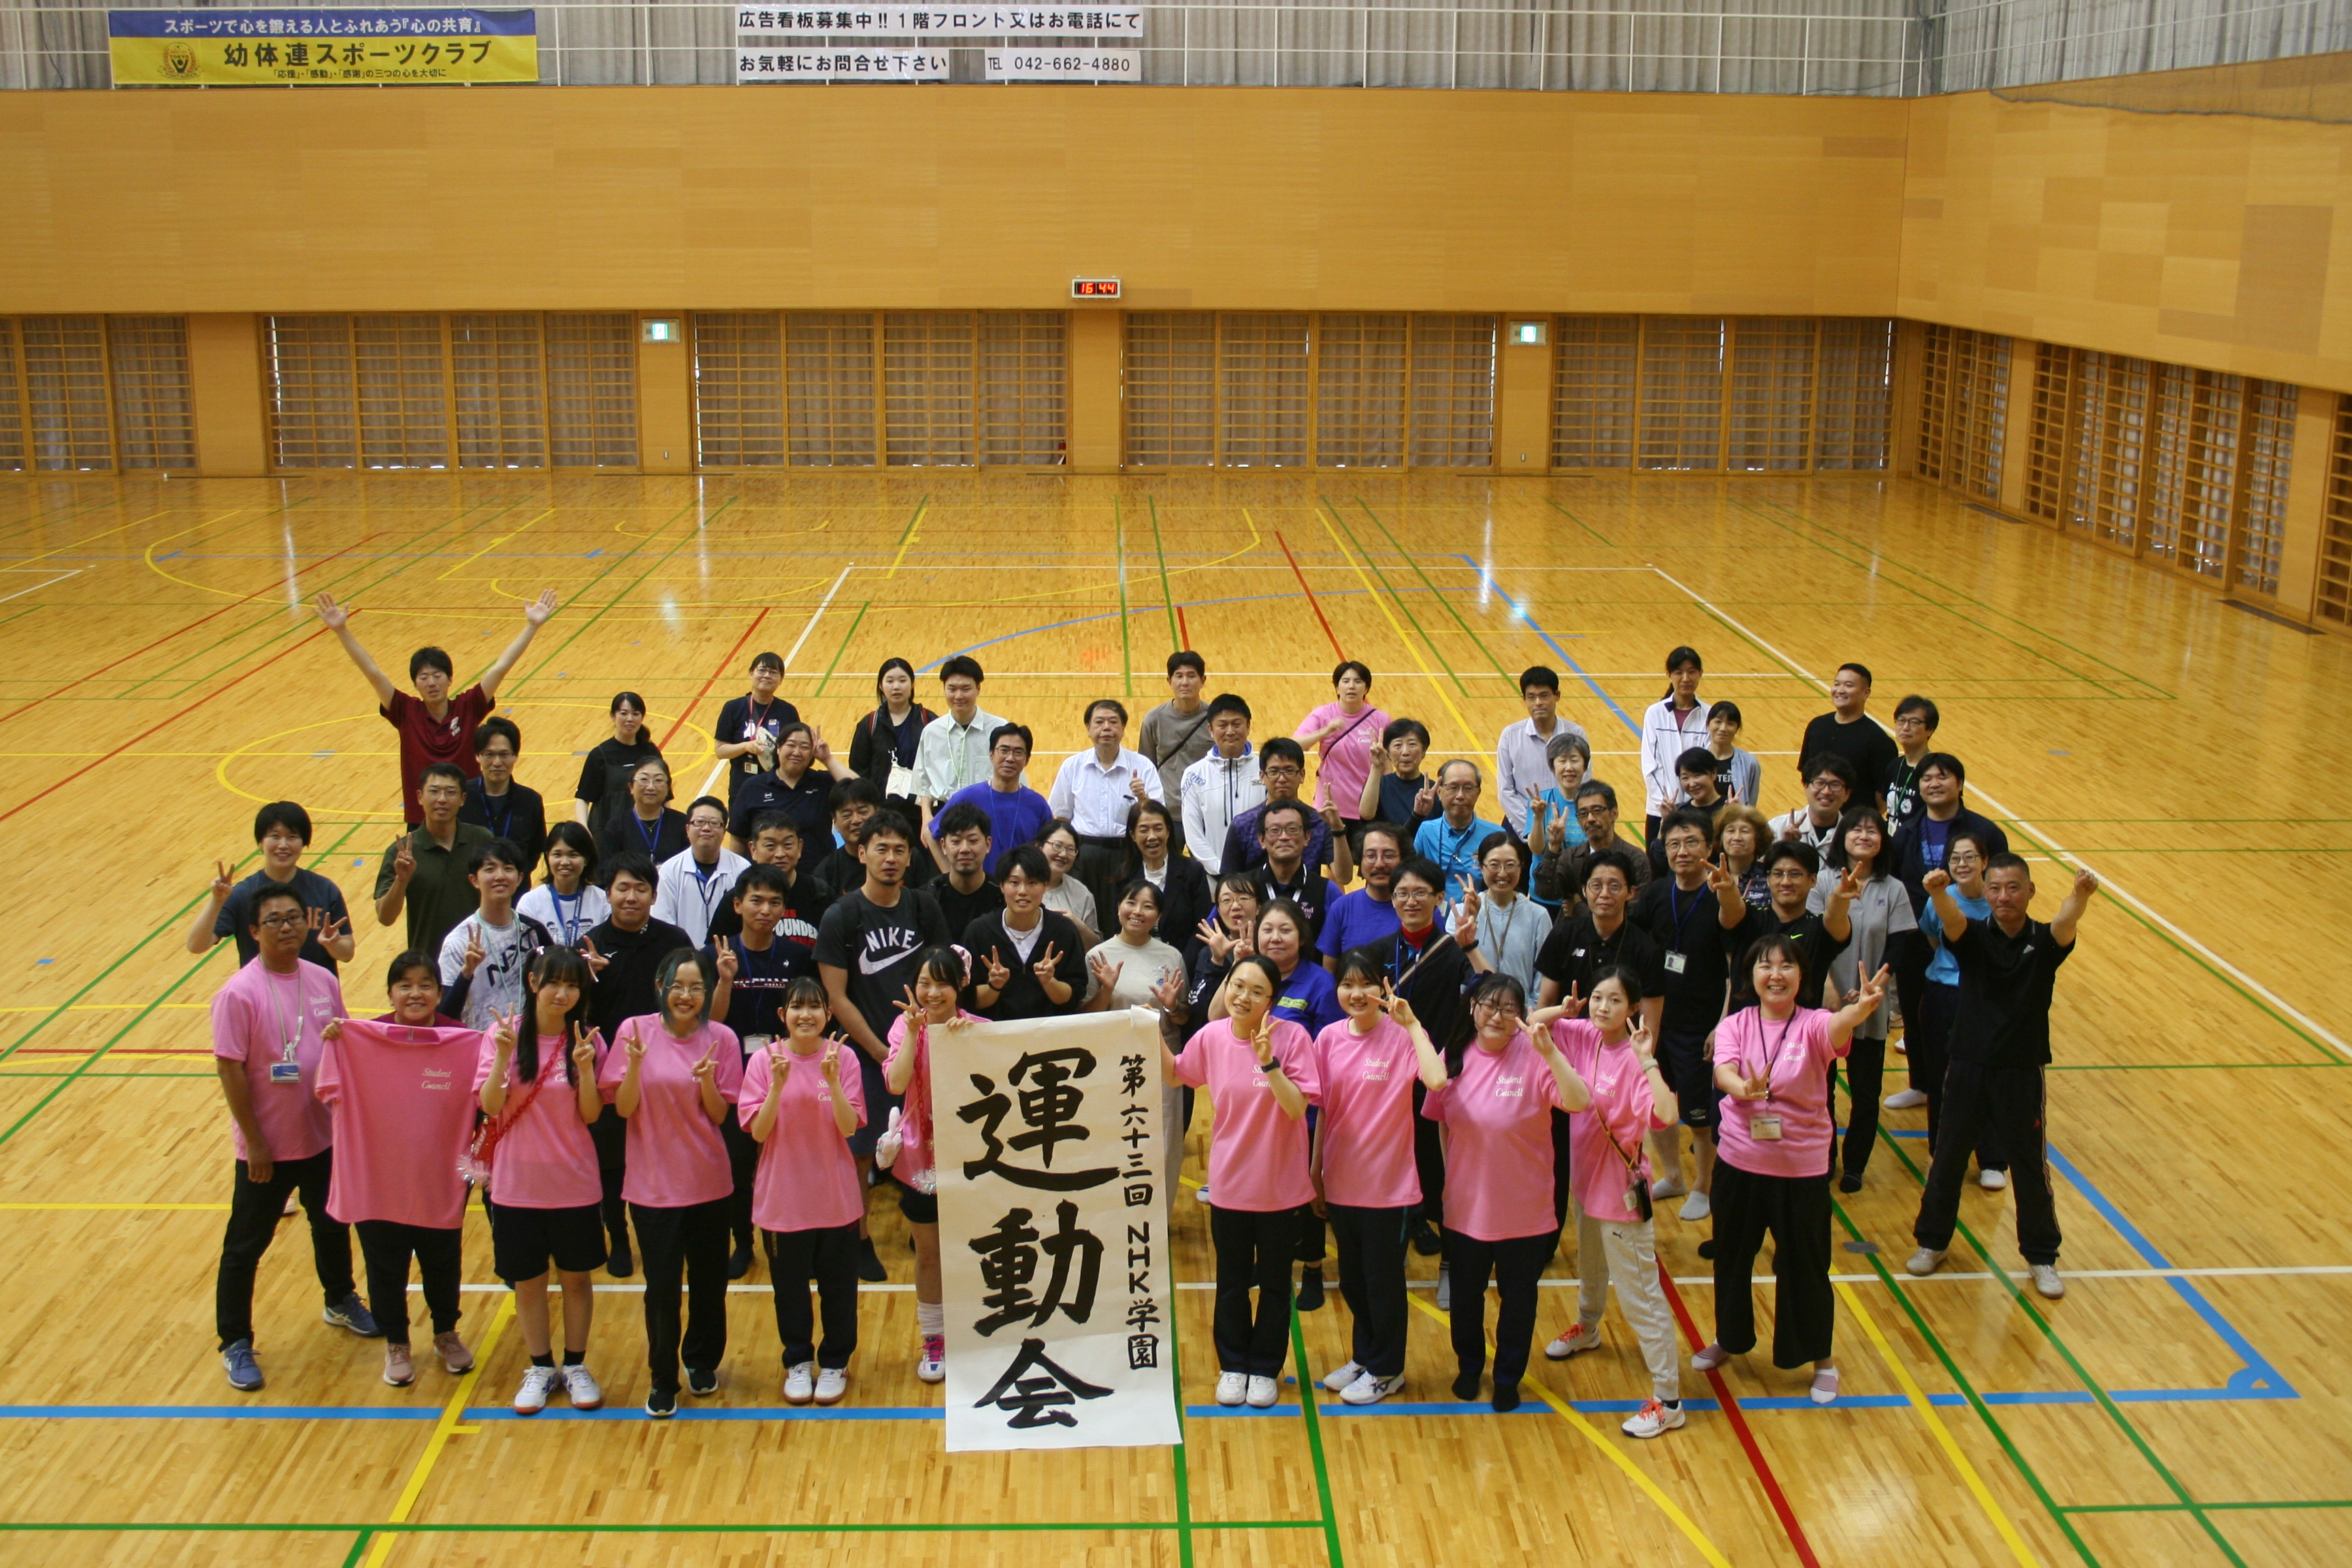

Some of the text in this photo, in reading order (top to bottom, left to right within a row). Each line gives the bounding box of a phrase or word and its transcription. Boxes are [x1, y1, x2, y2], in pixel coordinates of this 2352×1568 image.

[224, 40, 492, 67] 幼体連スポーツクラブ
[739, 54, 947, 72] お気軽にお問合せ下さい
[988, 56, 1130, 71] TEL 042-662-4880
[865, 926, 915, 952] NIKE
[1363, 1058, 1390, 1068] Student
[423, 1067, 452, 1078] Student
[1362, 1071, 1390, 1081] Council
[422, 1080, 451, 1090] Council
[1496, 1075, 1522, 1084] Student
[1495, 1088, 1523, 1097] Council
[1120, 1054, 1160, 1371] 第六十三回 NHK学園
[956, 1047, 1122, 1429] 運動会
